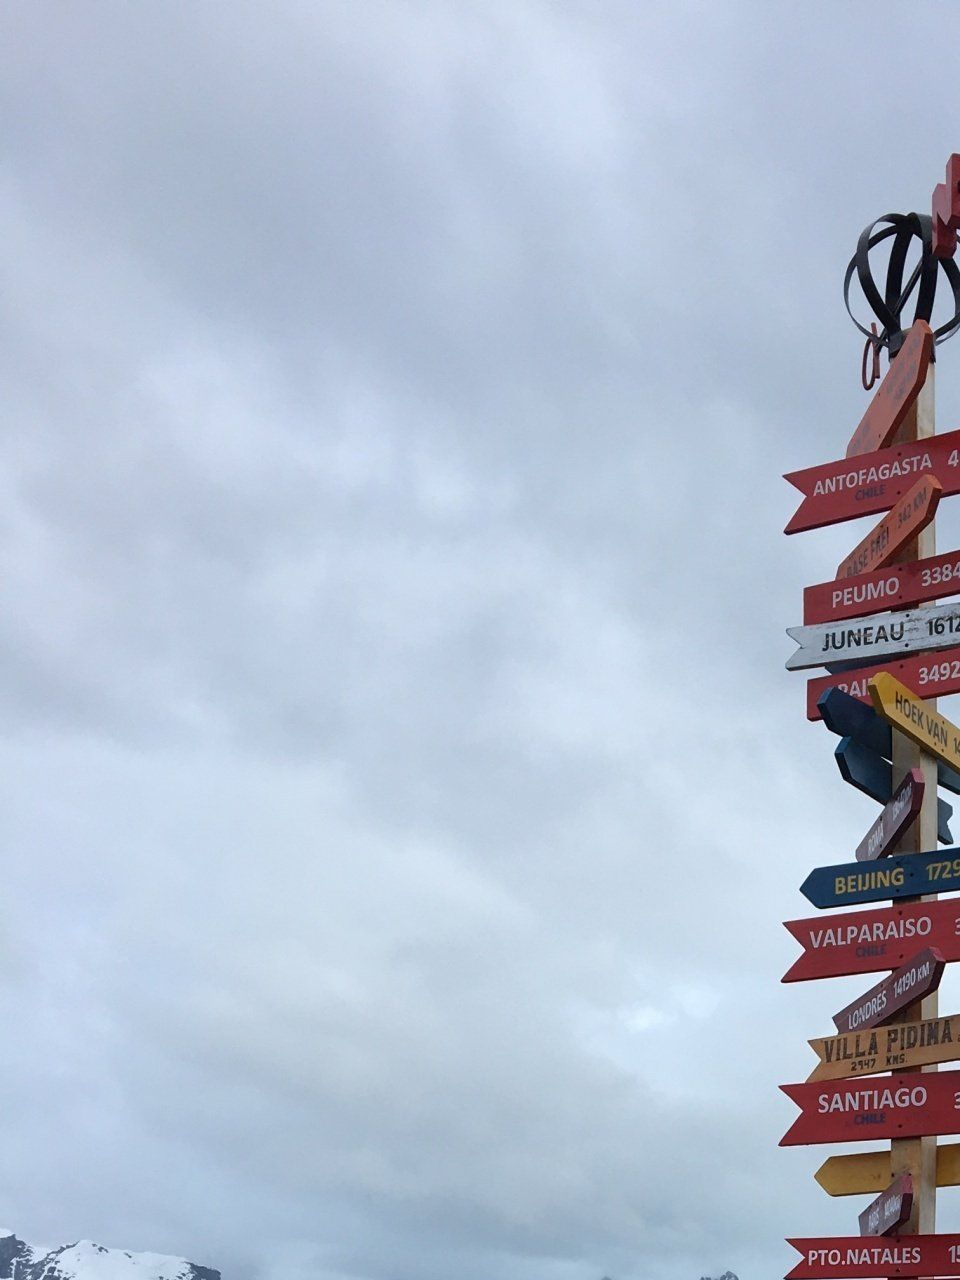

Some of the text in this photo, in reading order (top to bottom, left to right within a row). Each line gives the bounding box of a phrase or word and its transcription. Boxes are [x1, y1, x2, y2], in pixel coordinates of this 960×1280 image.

[813, 452, 932, 497] ANTOFAGASTA
[855, 484, 886, 501] CHILE
[832, 576, 900, 608] PEUMO
[822, 621, 904, 652] JUNEAU
[895, 691, 924, 729] HOEK
[926, 715, 948, 747] VAN
[834, 867, 905, 895] BEIJING
[809, 916, 932, 949] VALPARAISO
[855, 944, 887, 958] CHILE
[848, 990, 887, 1030] LONDRES
[823, 1020, 953, 1063] VILLA PIDIMA
[851, 1058, 876, 1071] 2947
[818, 1086, 928, 1114] SANTIAGO
[854, 1113, 886, 1125] CHILE
[807, 1247, 922, 1266] PTO.NATALES
